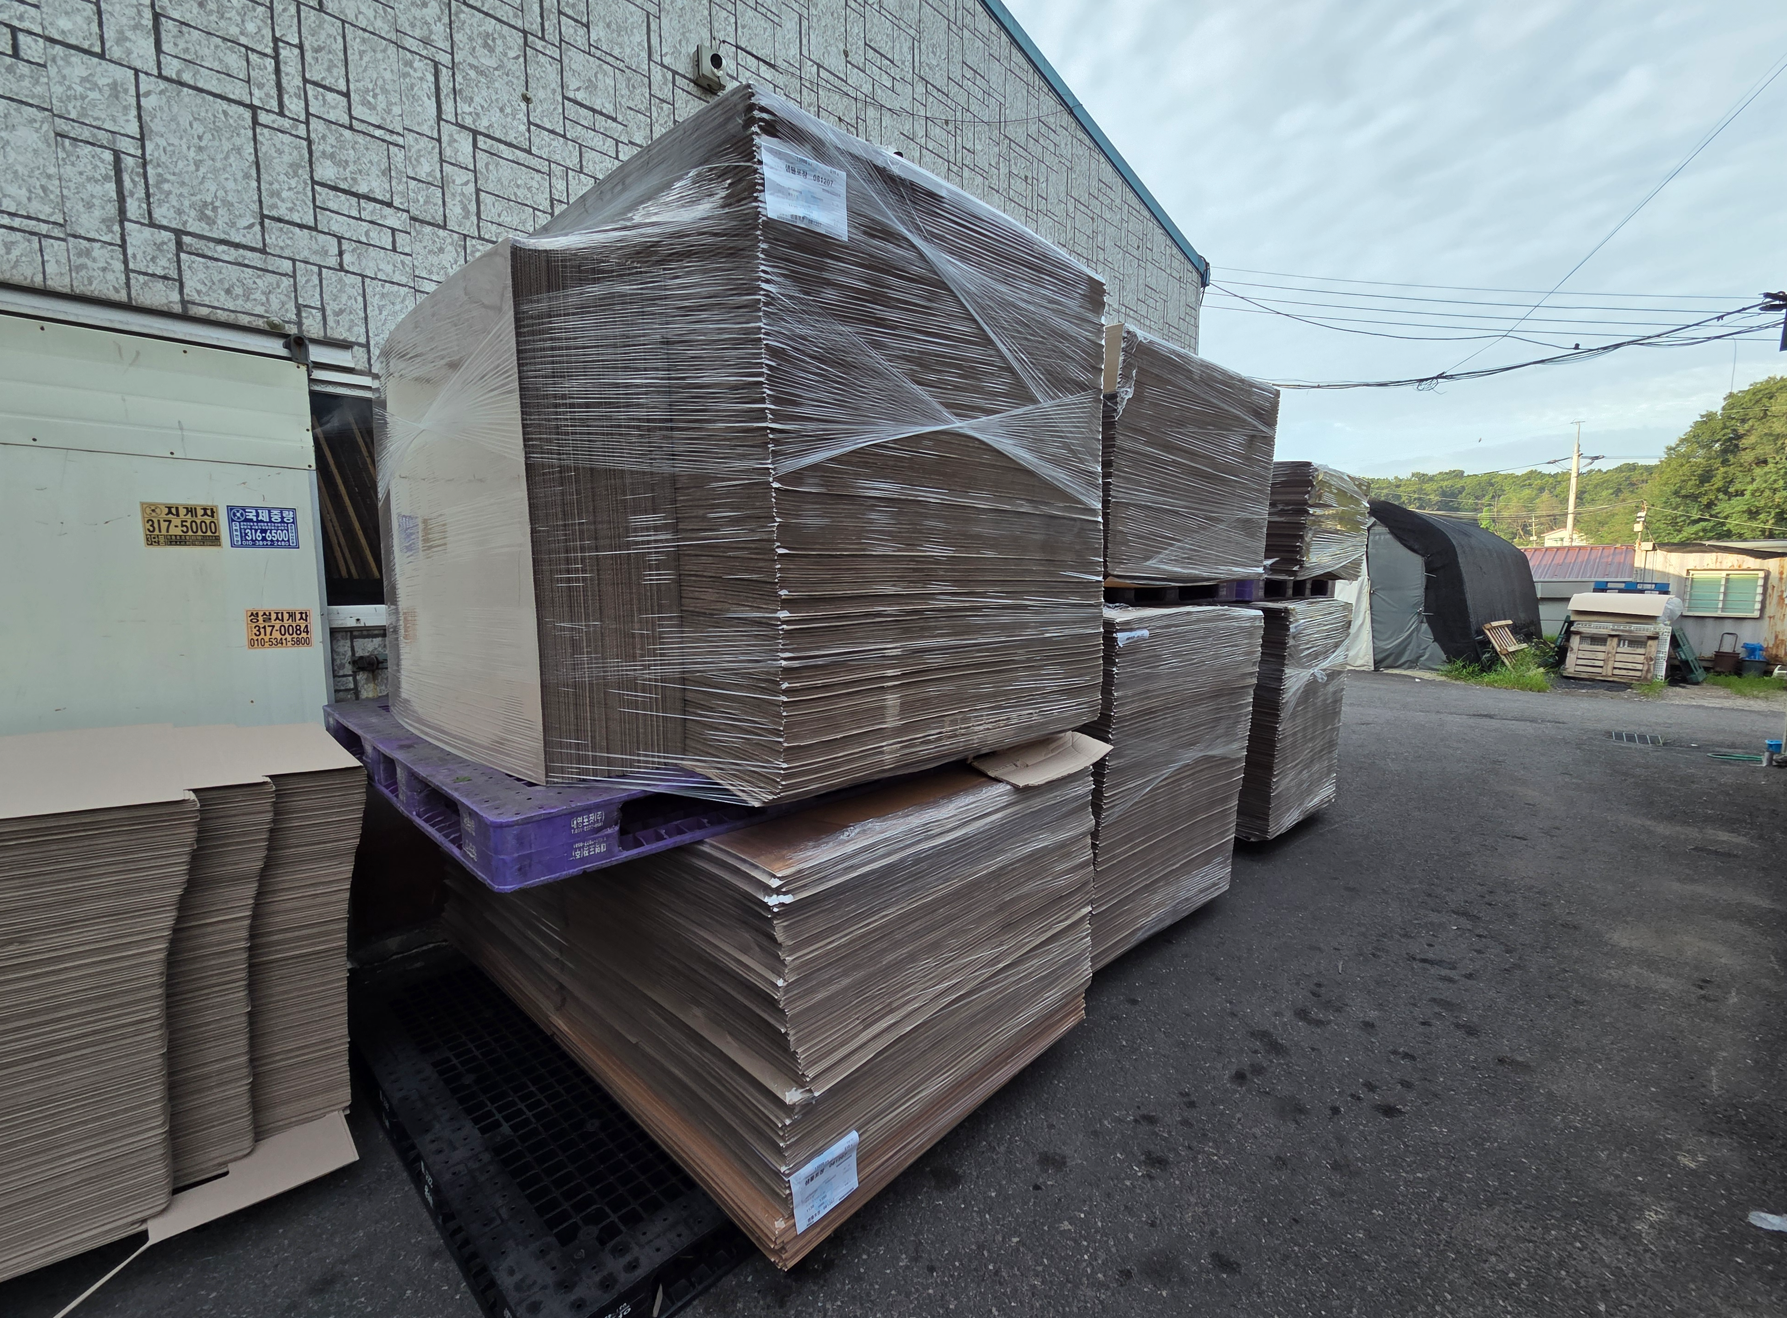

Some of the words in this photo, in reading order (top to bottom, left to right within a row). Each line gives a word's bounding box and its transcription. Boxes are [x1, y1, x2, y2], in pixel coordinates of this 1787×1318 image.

[245, 509, 294, 523] 국제중량
[146, 519, 218, 534] 317-5000
[245, 529, 289, 541] 316-6500
[253, 624, 310, 637] 317-0084
[250, 636, 310, 648] 010-5341-5800
